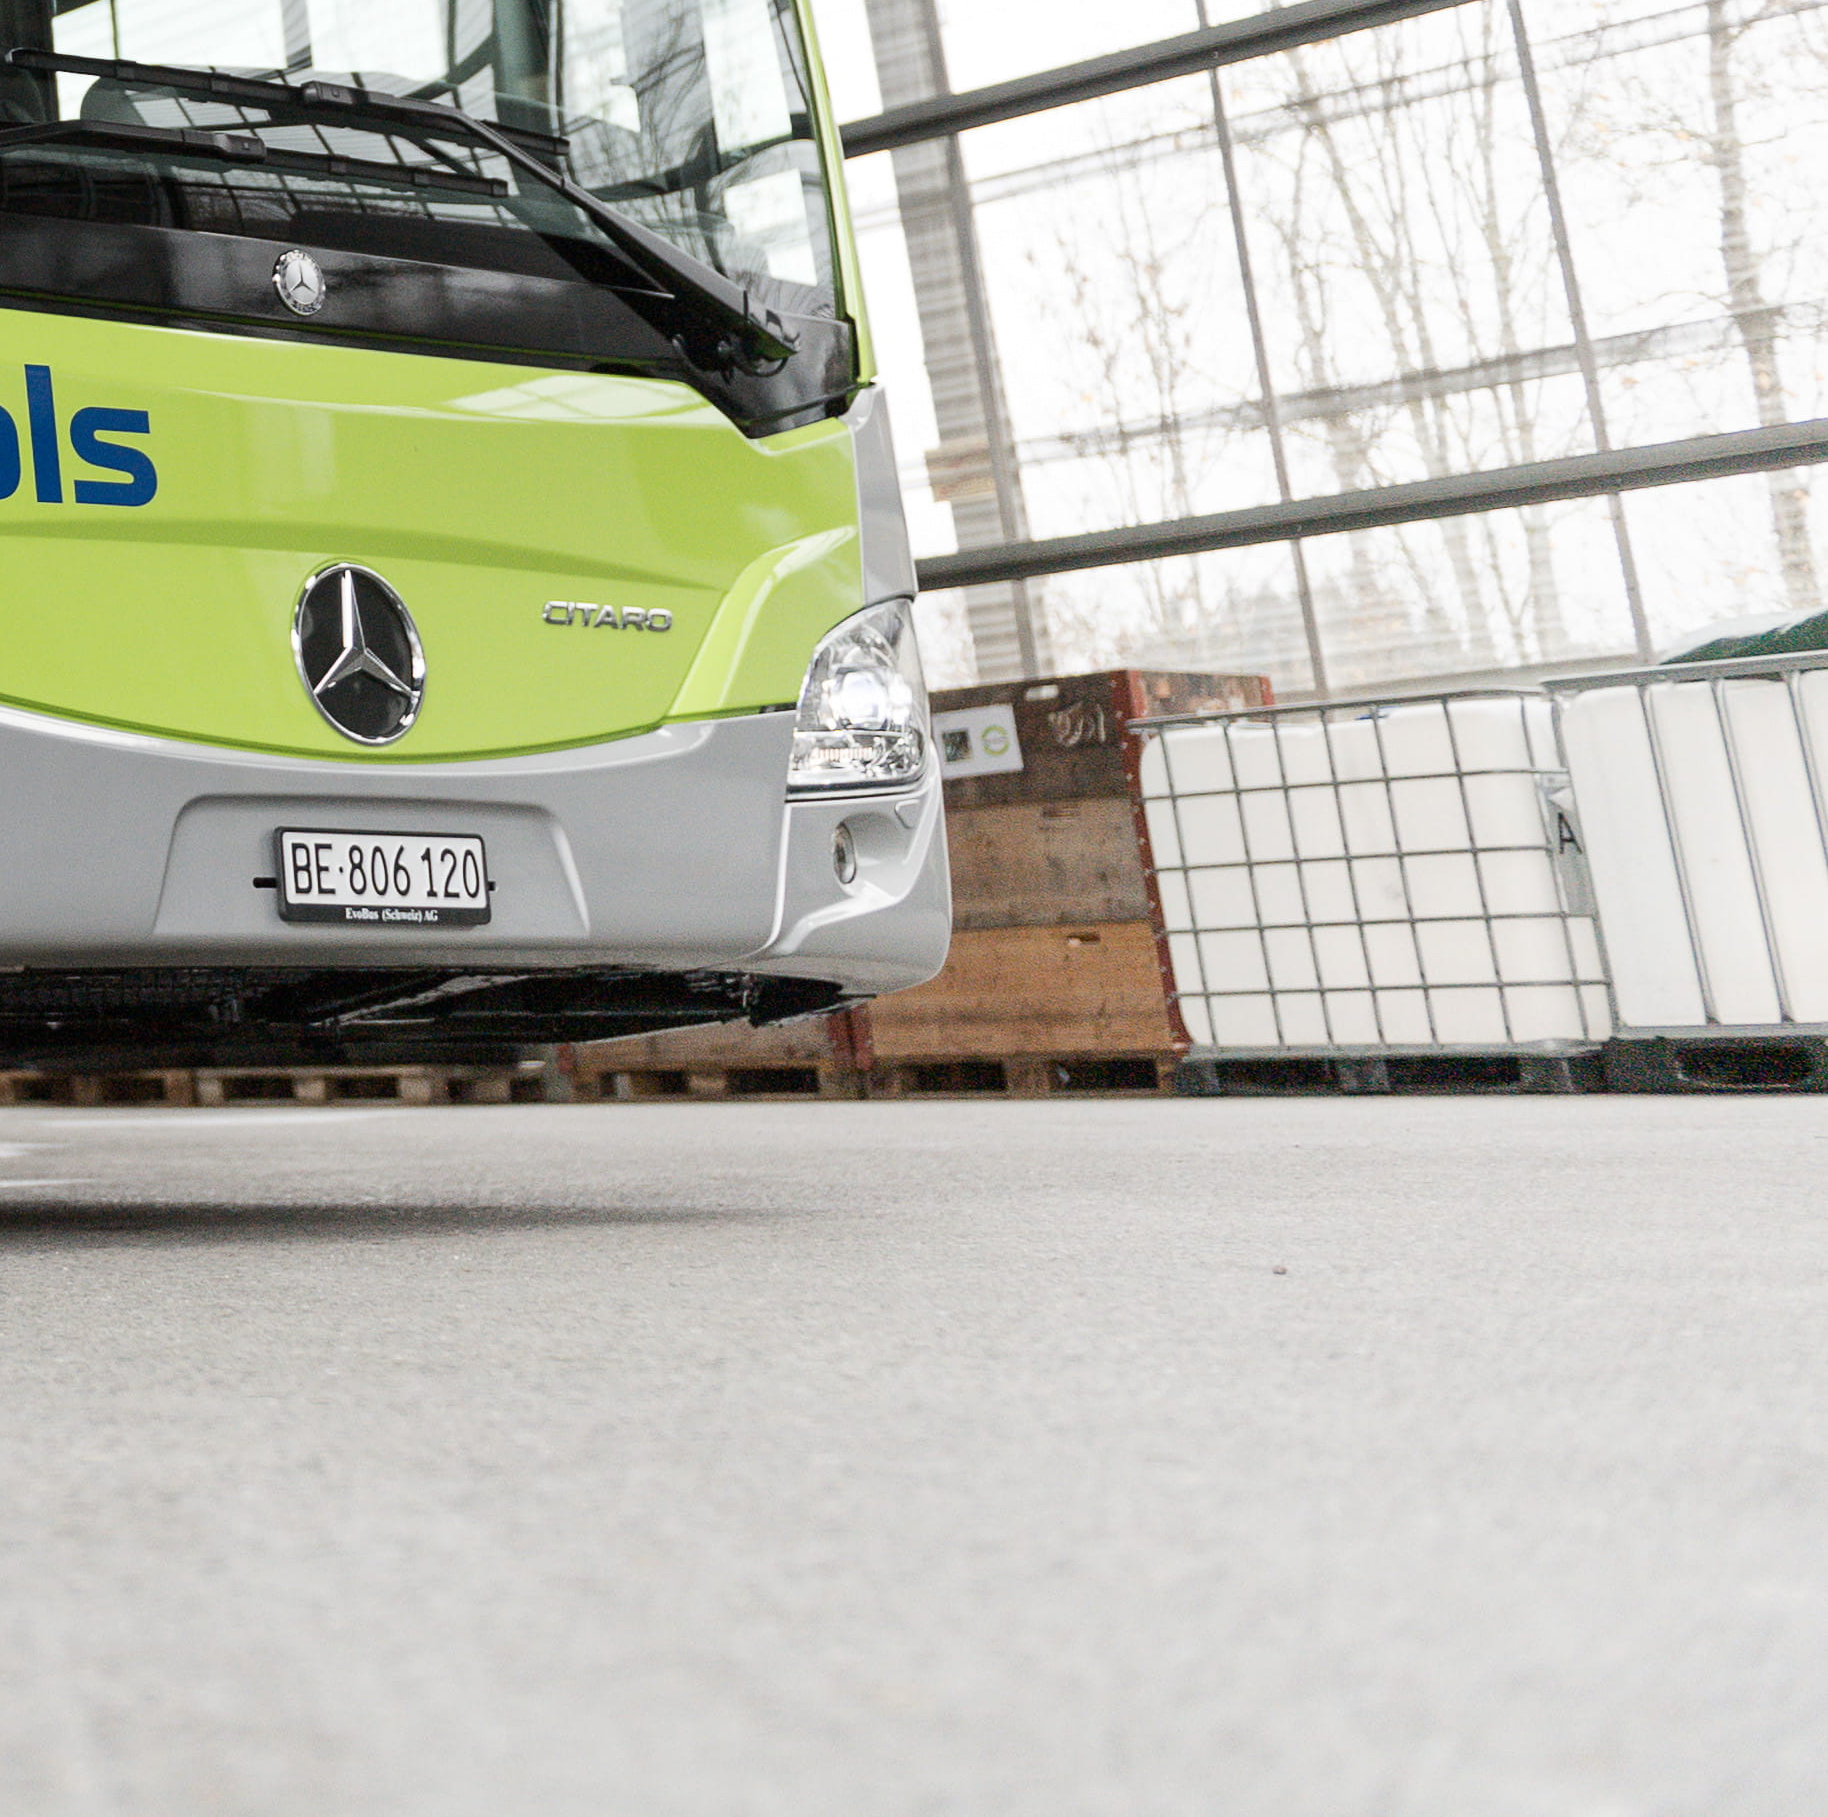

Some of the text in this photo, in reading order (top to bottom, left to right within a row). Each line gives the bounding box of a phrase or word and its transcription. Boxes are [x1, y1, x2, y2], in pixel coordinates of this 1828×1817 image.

[542, 600, 672, 632] CITARO
[420, 847, 479, 898] 120
[345, 907, 379, 920] EvoBus
[424, 909, 438, 921] AG
